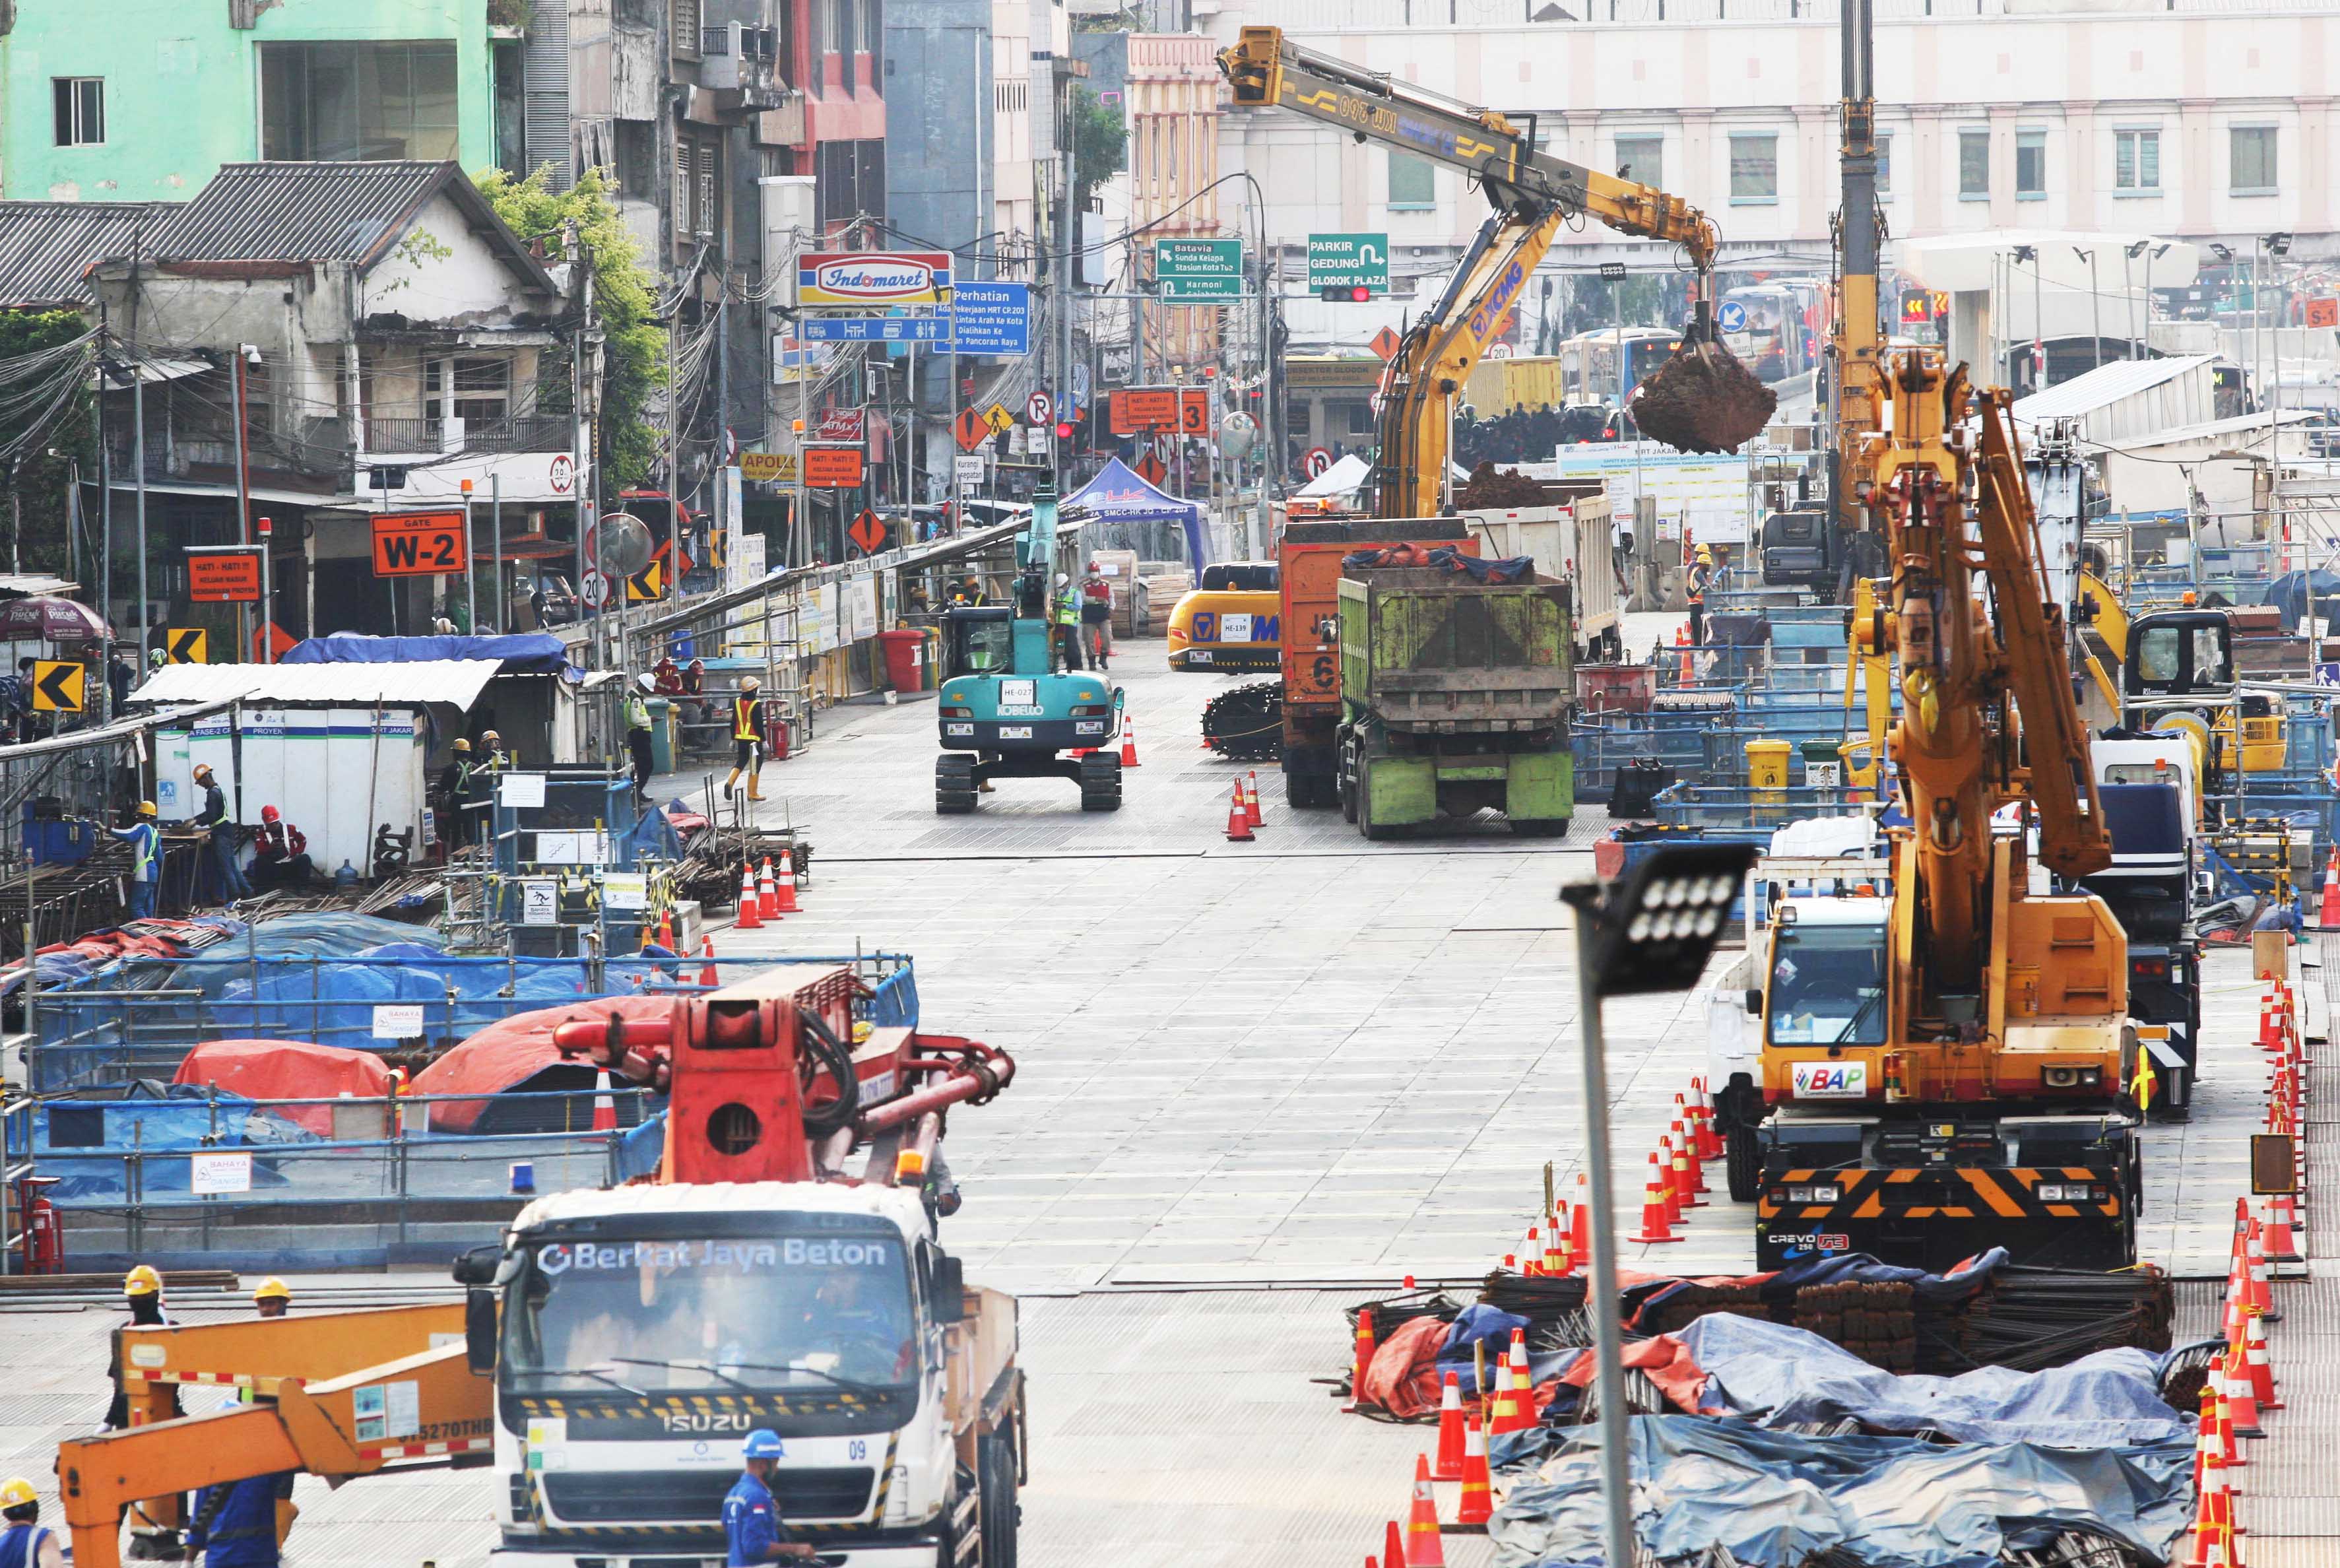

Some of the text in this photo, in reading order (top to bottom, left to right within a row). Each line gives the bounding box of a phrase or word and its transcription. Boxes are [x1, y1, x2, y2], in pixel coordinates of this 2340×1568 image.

[1311, 242, 1353, 251] PARKIR
[1199, 254, 1224, 263] Kelapa
[1311, 258, 1359, 269] GEDUNG
[826, 269, 923, 287] Indomaret
[1311, 276, 1387, 285] GLODOK PLAZA
[955, 290, 1010, 302] Perhatian
[1483, 261, 1523, 326] XCMG
[2312, 309, 2334, 325] S-1
[1001, 338, 1018, 347] Raya
[958, 459, 979, 470] Kurangi
[383, 534, 456, 568] W-2
[1809, 1068, 1863, 1090] BAP
[1769, 1234, 1815, 1243] CREVO
[574, 1239, 886, 1273] Berkat Jaya Beton
[663, 1414, 751, 1432] ISUZU
[849, 1440, 866, 1460] 09
